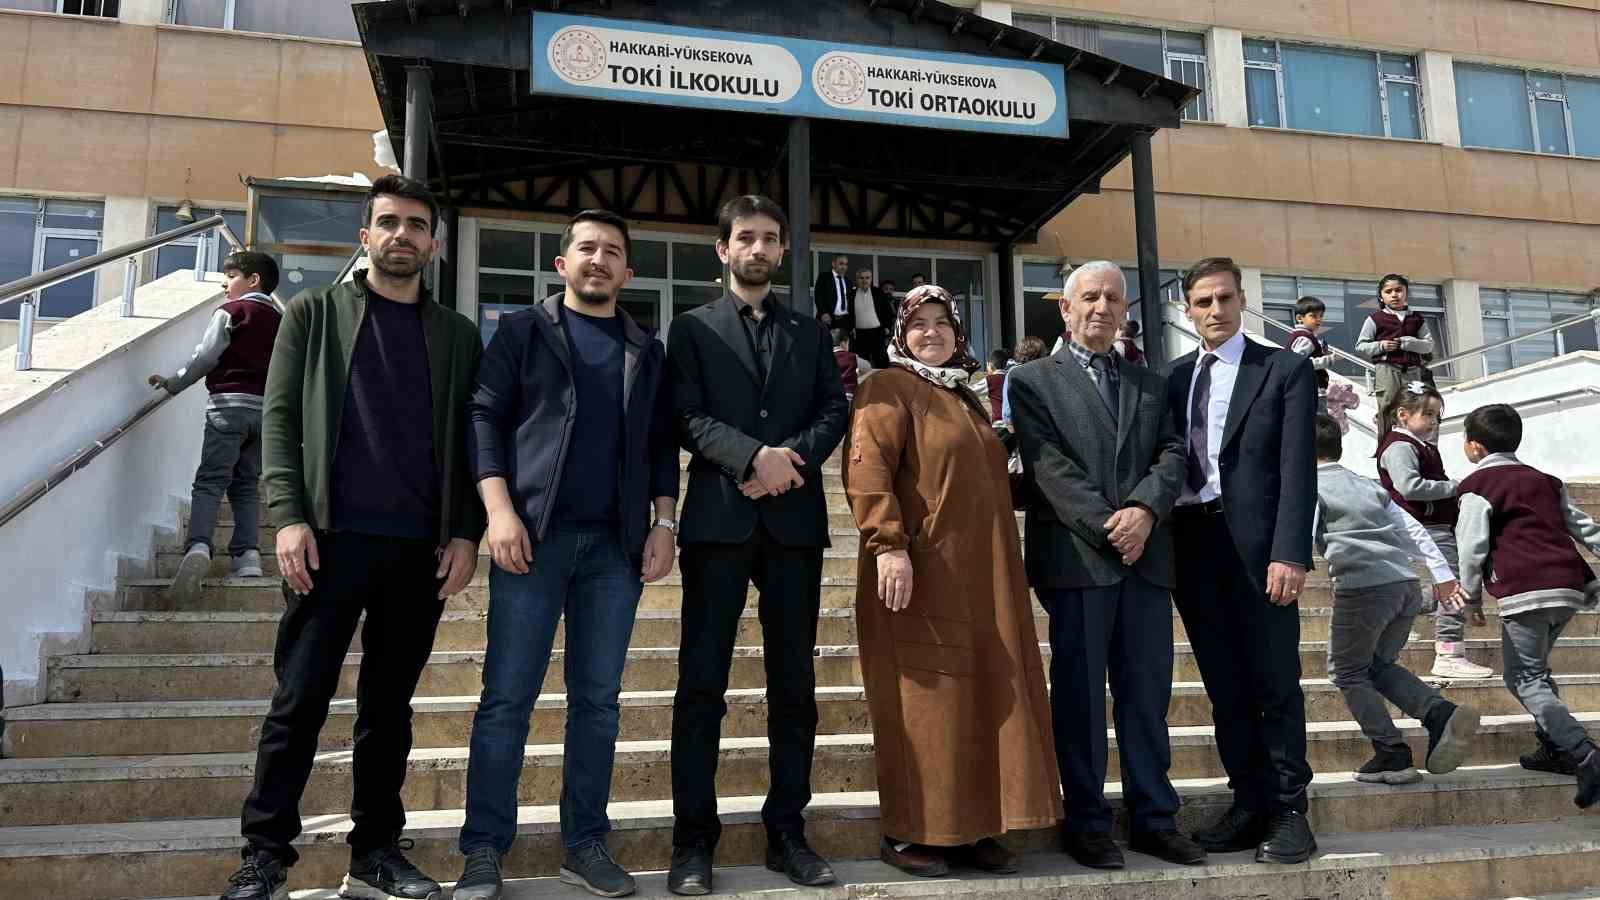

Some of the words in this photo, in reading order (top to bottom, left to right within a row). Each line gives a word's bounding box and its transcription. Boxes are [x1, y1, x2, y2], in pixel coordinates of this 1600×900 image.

[609, 40, 753, 66] HAKKARİ-YÜKSEKOVA
[607, 64, 662, 88] TOKİ
[669, 65, 779, 98] İLKOKULU
[867, 66, 997, 89] HAKKARİ-YÜKSEKOVA
[867, 87, 914, 110] TOKİ
[919, 93, 1036, 120] ORTAOKULU
